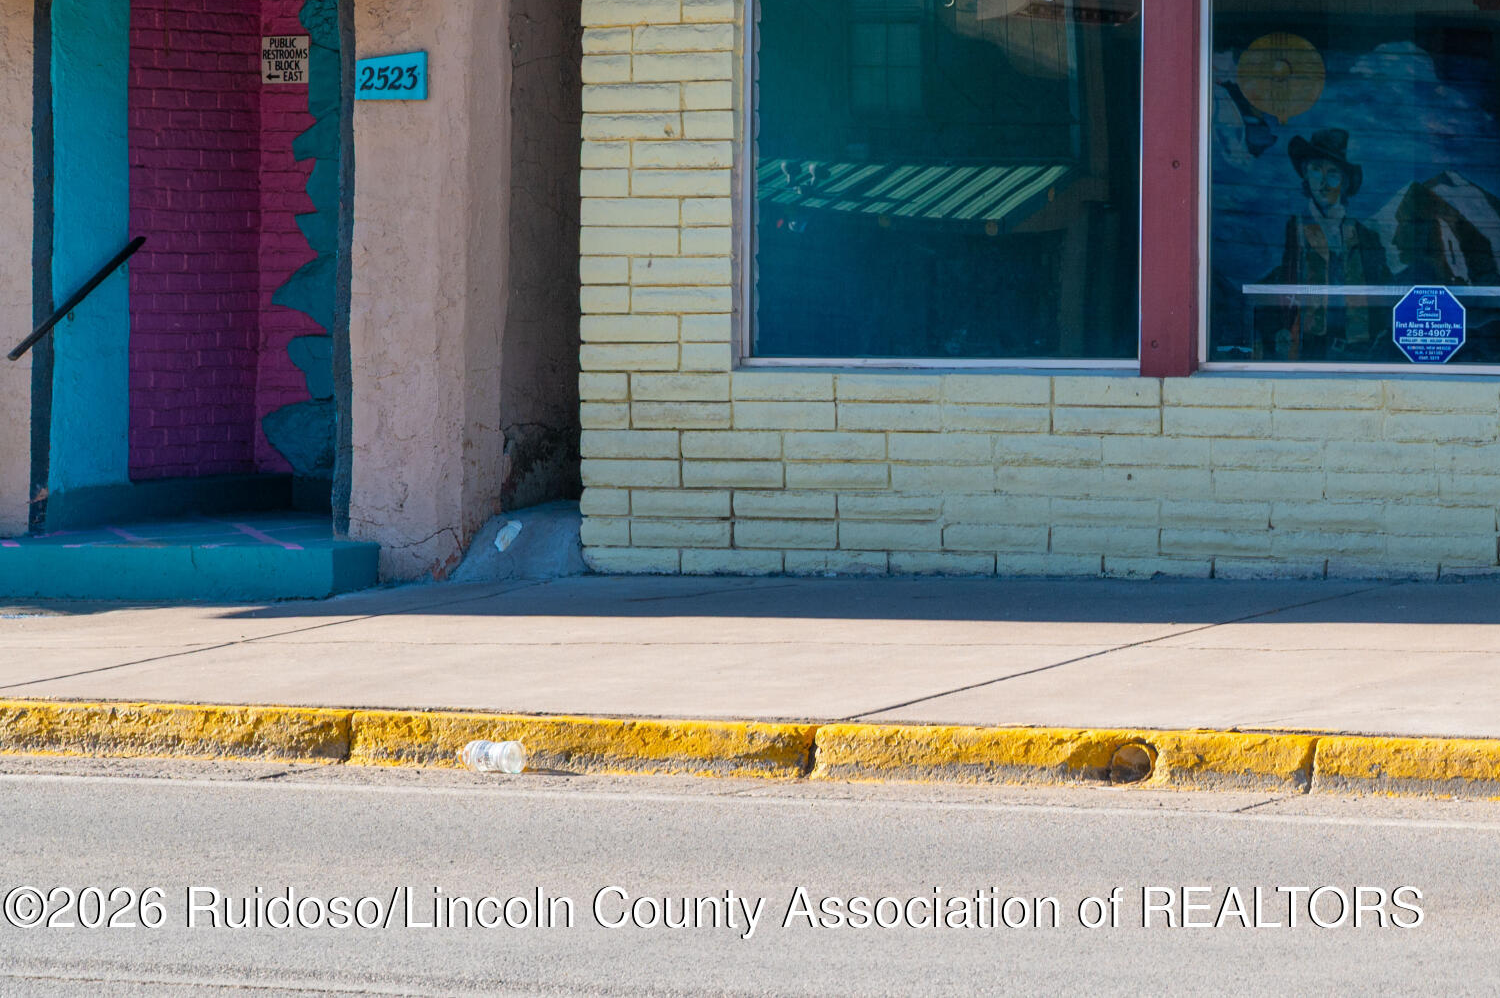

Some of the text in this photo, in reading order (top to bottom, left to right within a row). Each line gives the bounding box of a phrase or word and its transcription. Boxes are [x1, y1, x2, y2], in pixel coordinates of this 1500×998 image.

[269, 37, 297, 49] PUBLIC
[262, 48, 308, 60] RESTROOMS
[267, 60, 300, 71] 1 BLOCK
[283, 71, 304, 82] EAST
[360, 64, 418, 91] 2523
[1406, 329, 1452, 337] 258-4907
